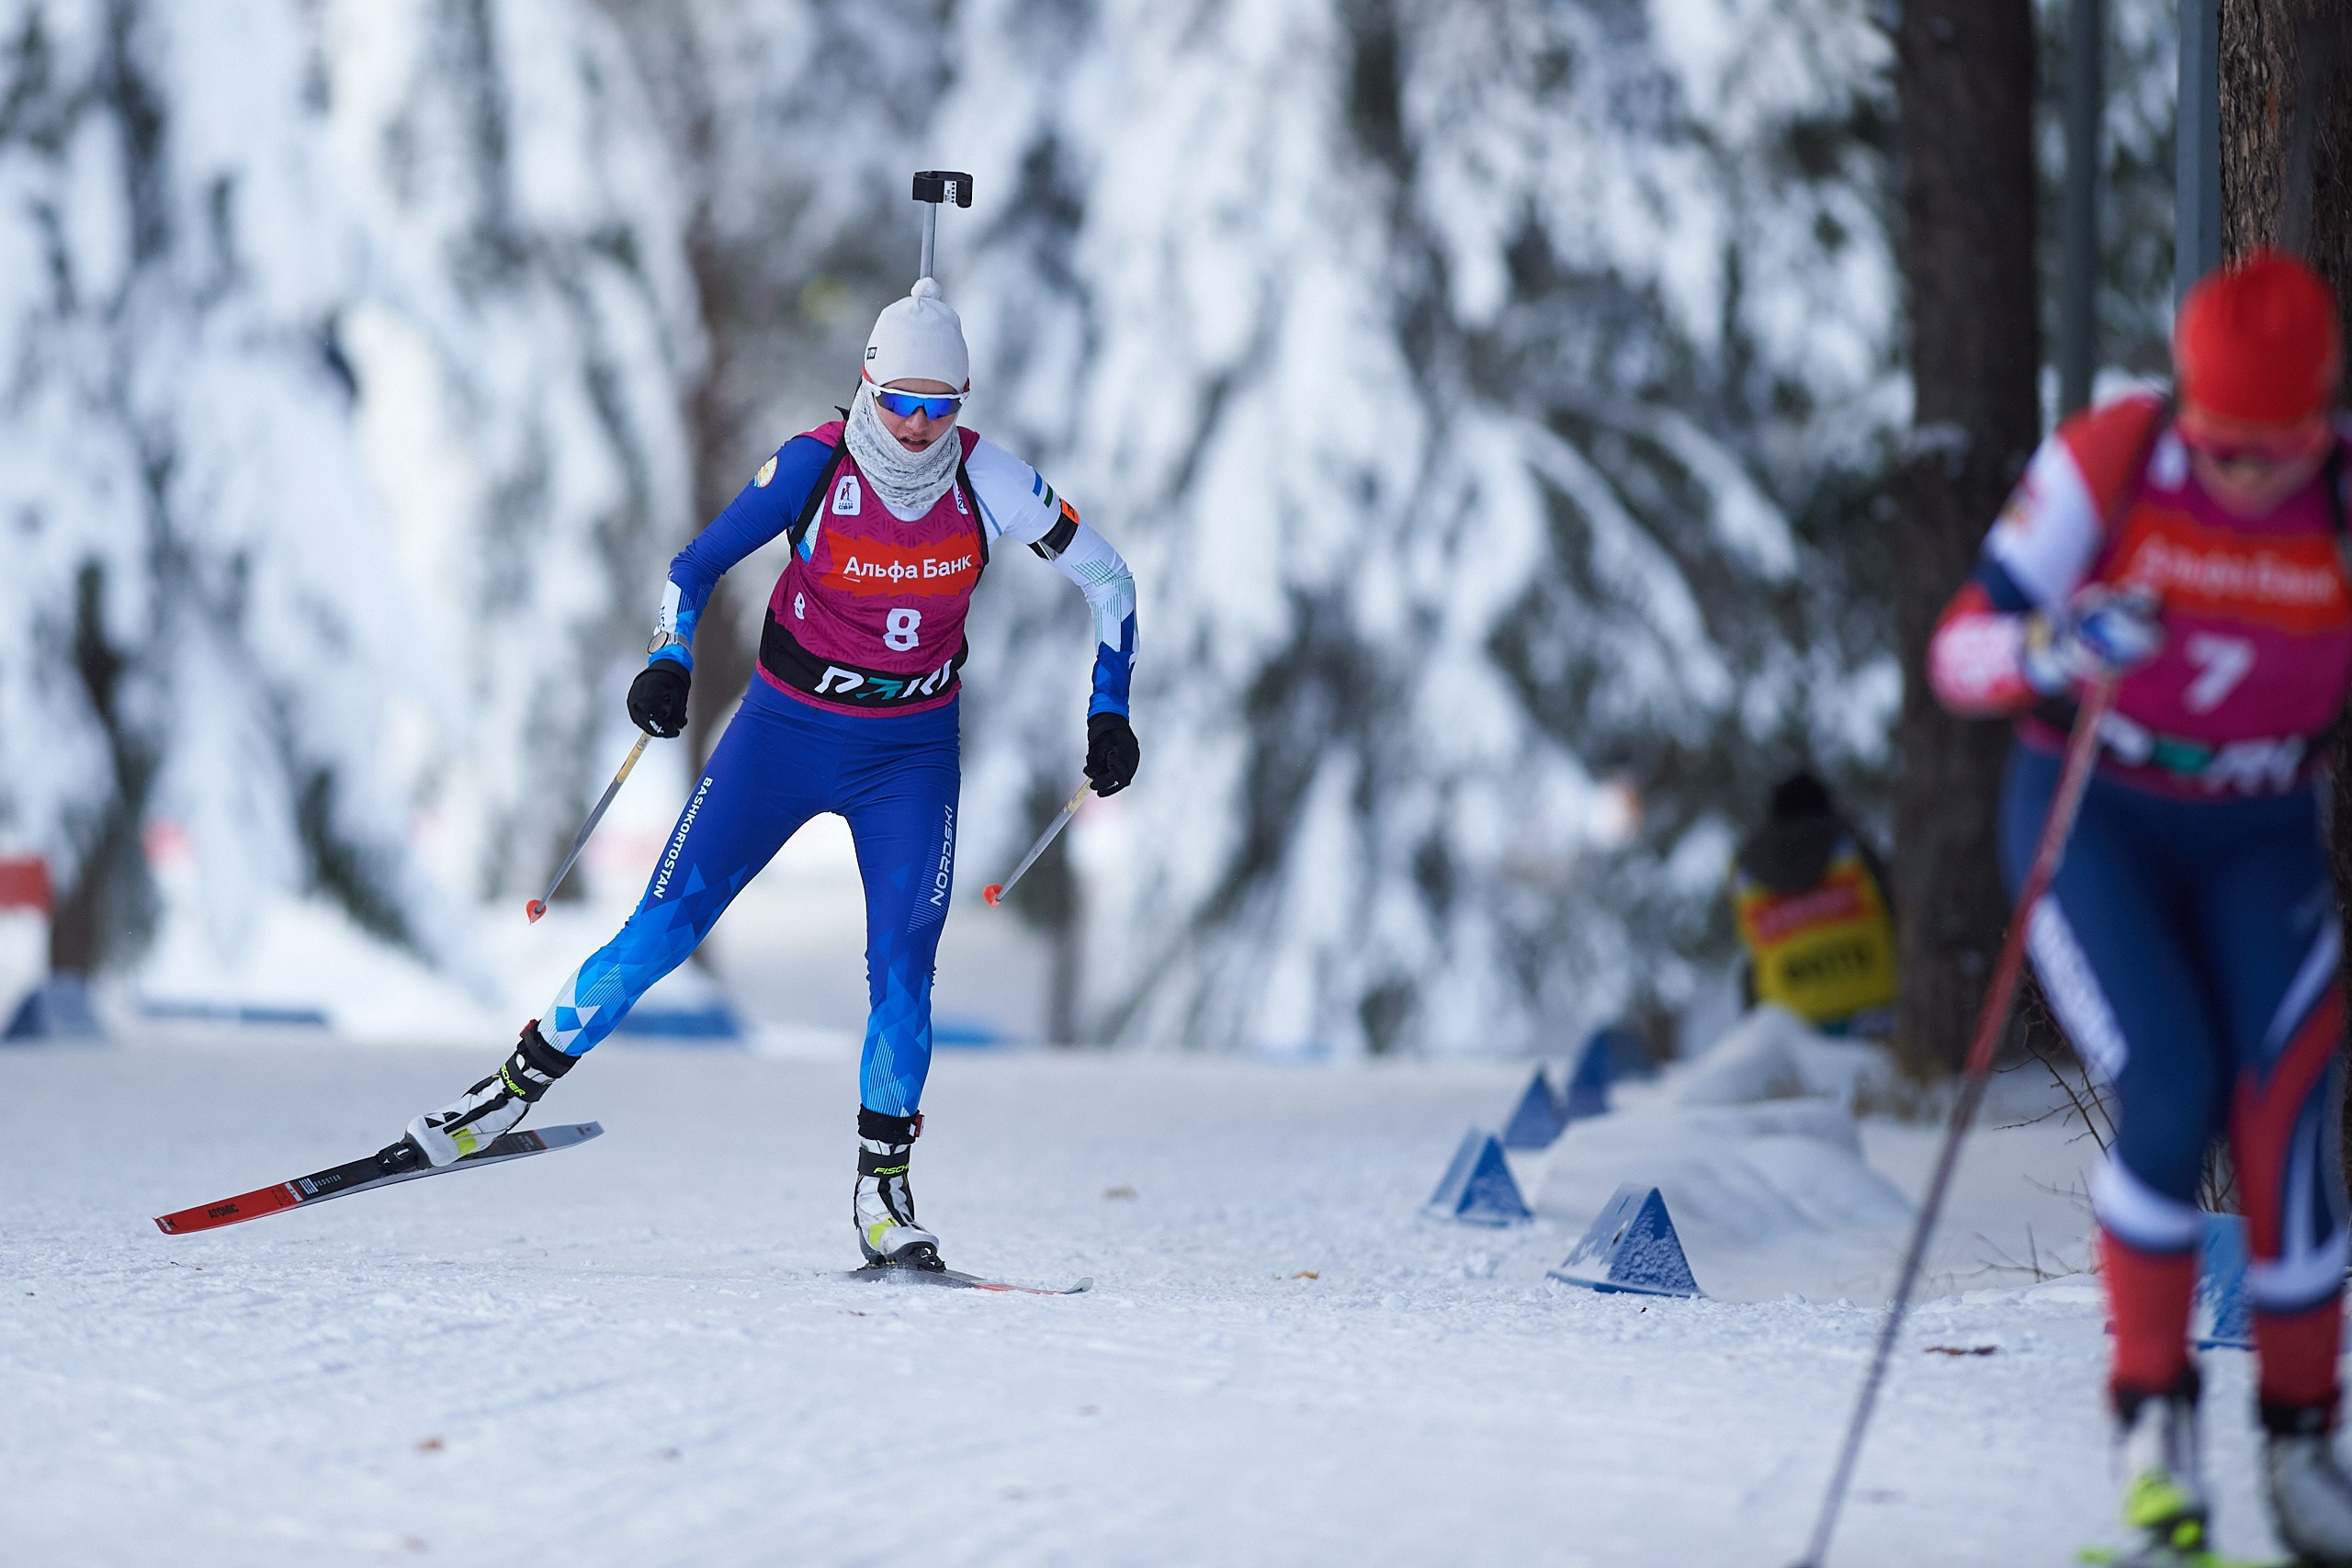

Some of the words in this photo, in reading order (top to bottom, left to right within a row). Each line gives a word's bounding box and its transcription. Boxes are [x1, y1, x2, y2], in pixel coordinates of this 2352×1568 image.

[843, 556, 918, 583] Альфа
[923, 554, 972, 578] Банк
[882, 607, 922, 651] 8
[2182, 632, 2256, 716] 7
[653, 776, 713, 899] BASHKORTOSTAN
[930, 805, 953, 907] NORDSKI
[208, 1203, 240, 1219] ATOMIC
